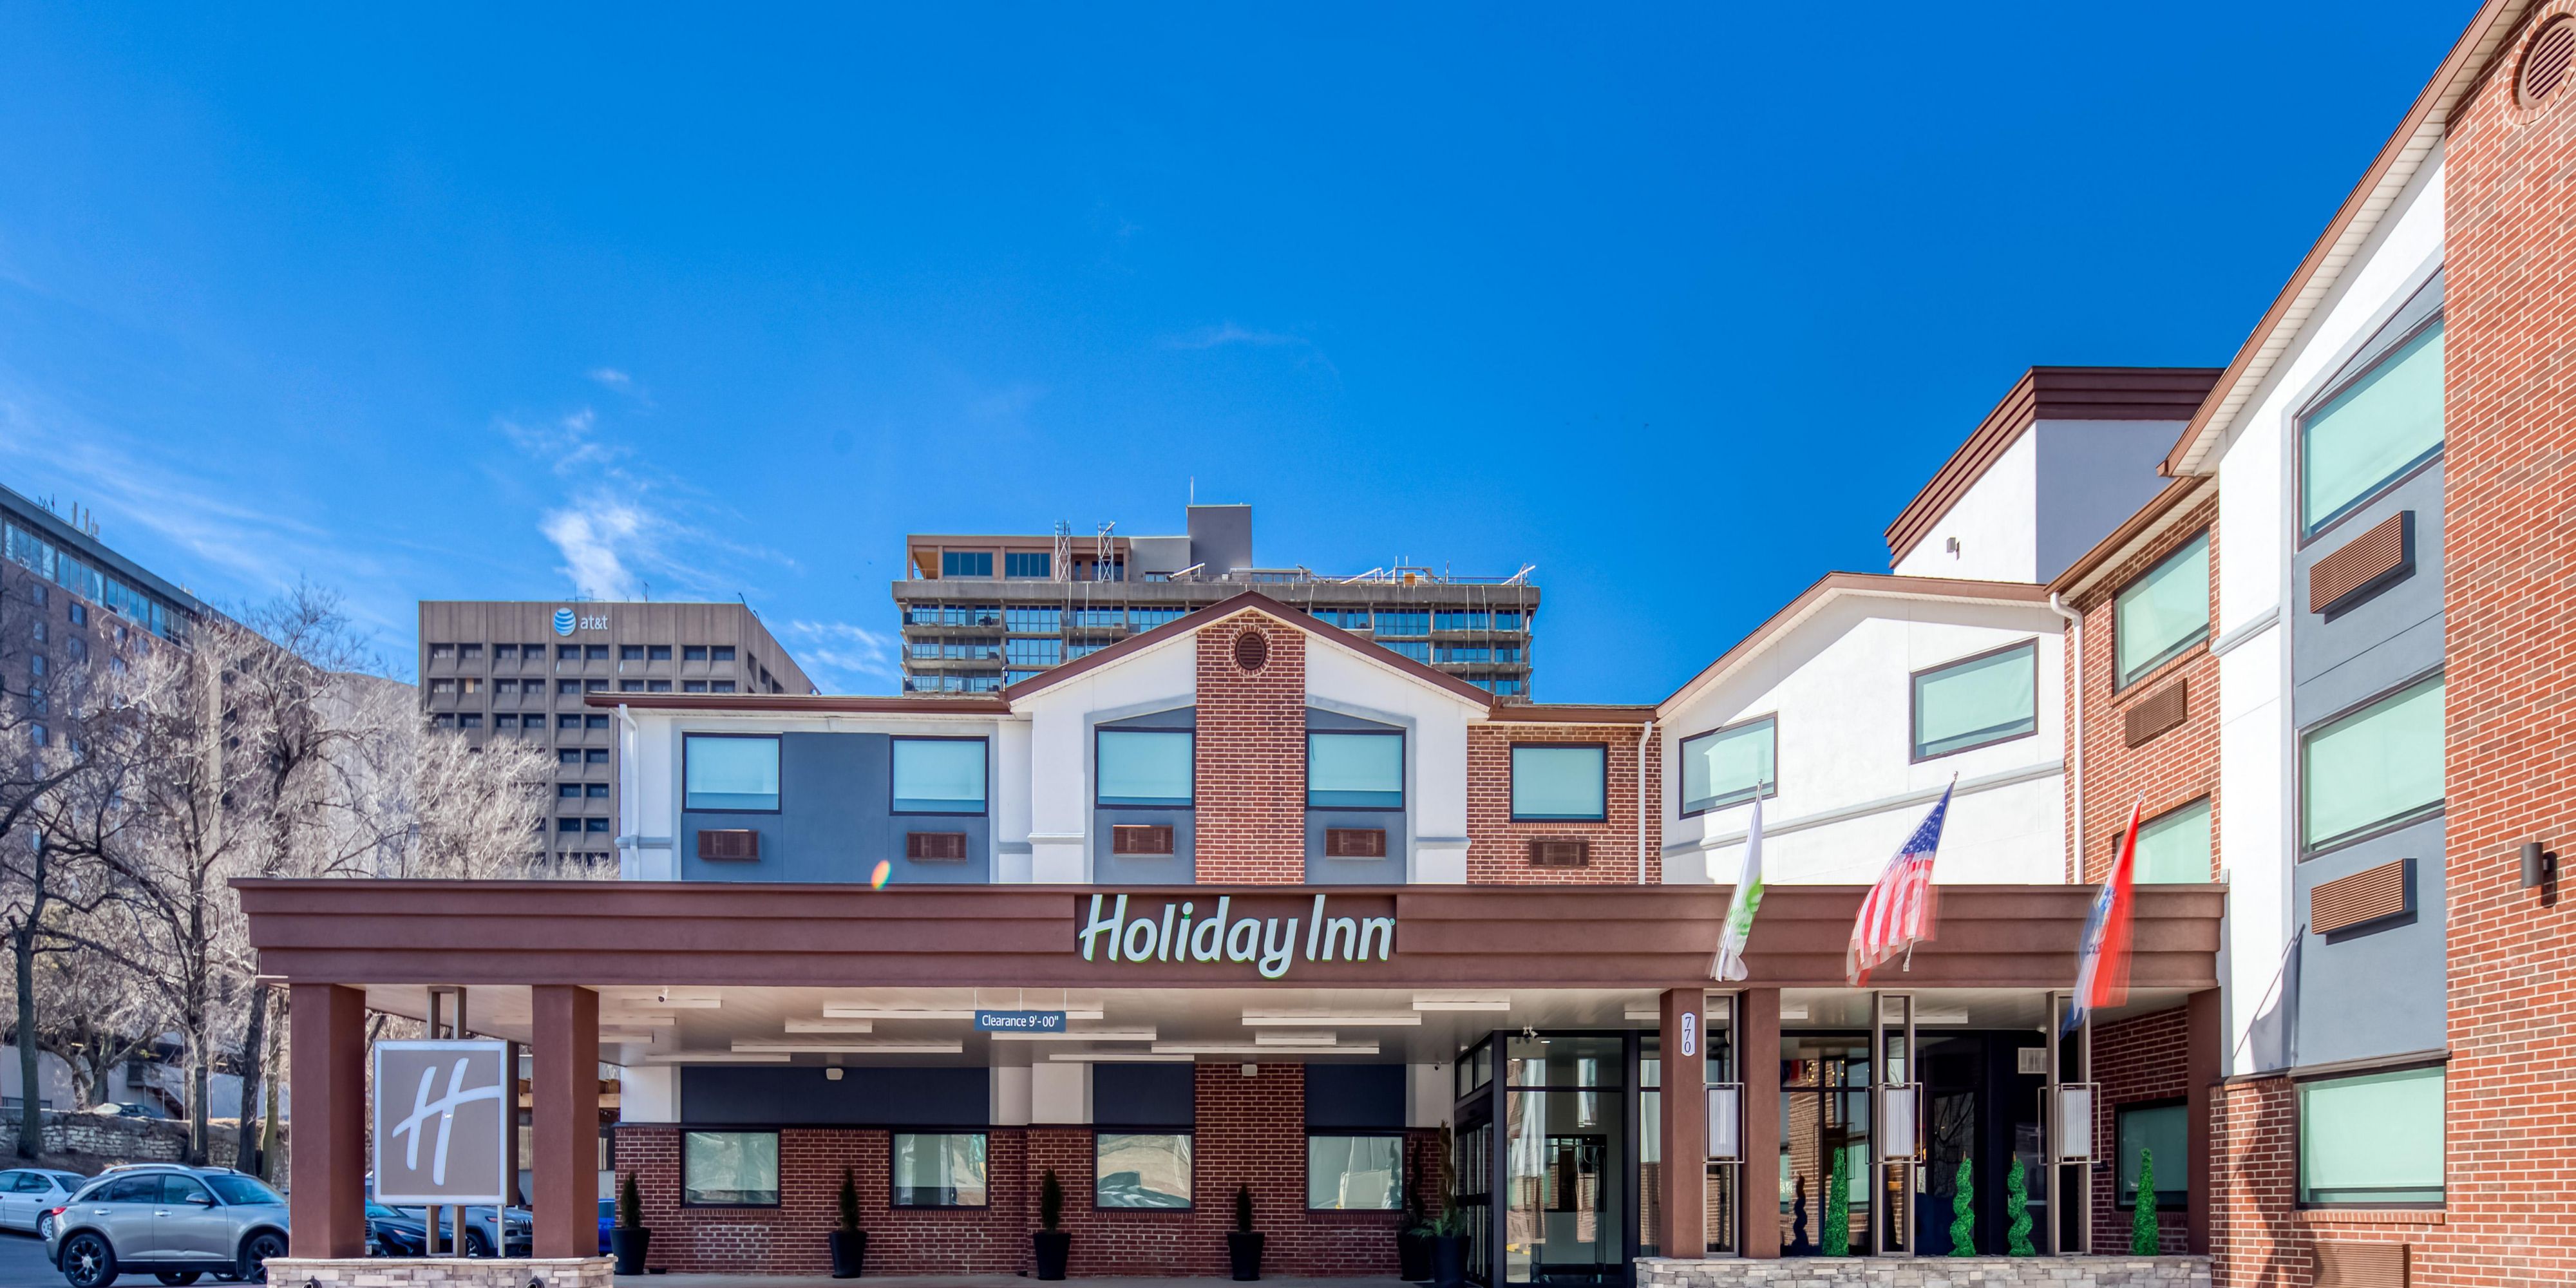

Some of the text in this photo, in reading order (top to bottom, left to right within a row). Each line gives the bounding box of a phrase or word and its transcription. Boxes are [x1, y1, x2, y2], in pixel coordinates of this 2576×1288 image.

[580, 614, 608, 630] at&t
[1079, 894, 1394, 980] Holiday Inn
[981, 1014, 1059, 1027] Clearance 9'-00"
[392, 1057, 500, 1186] H
